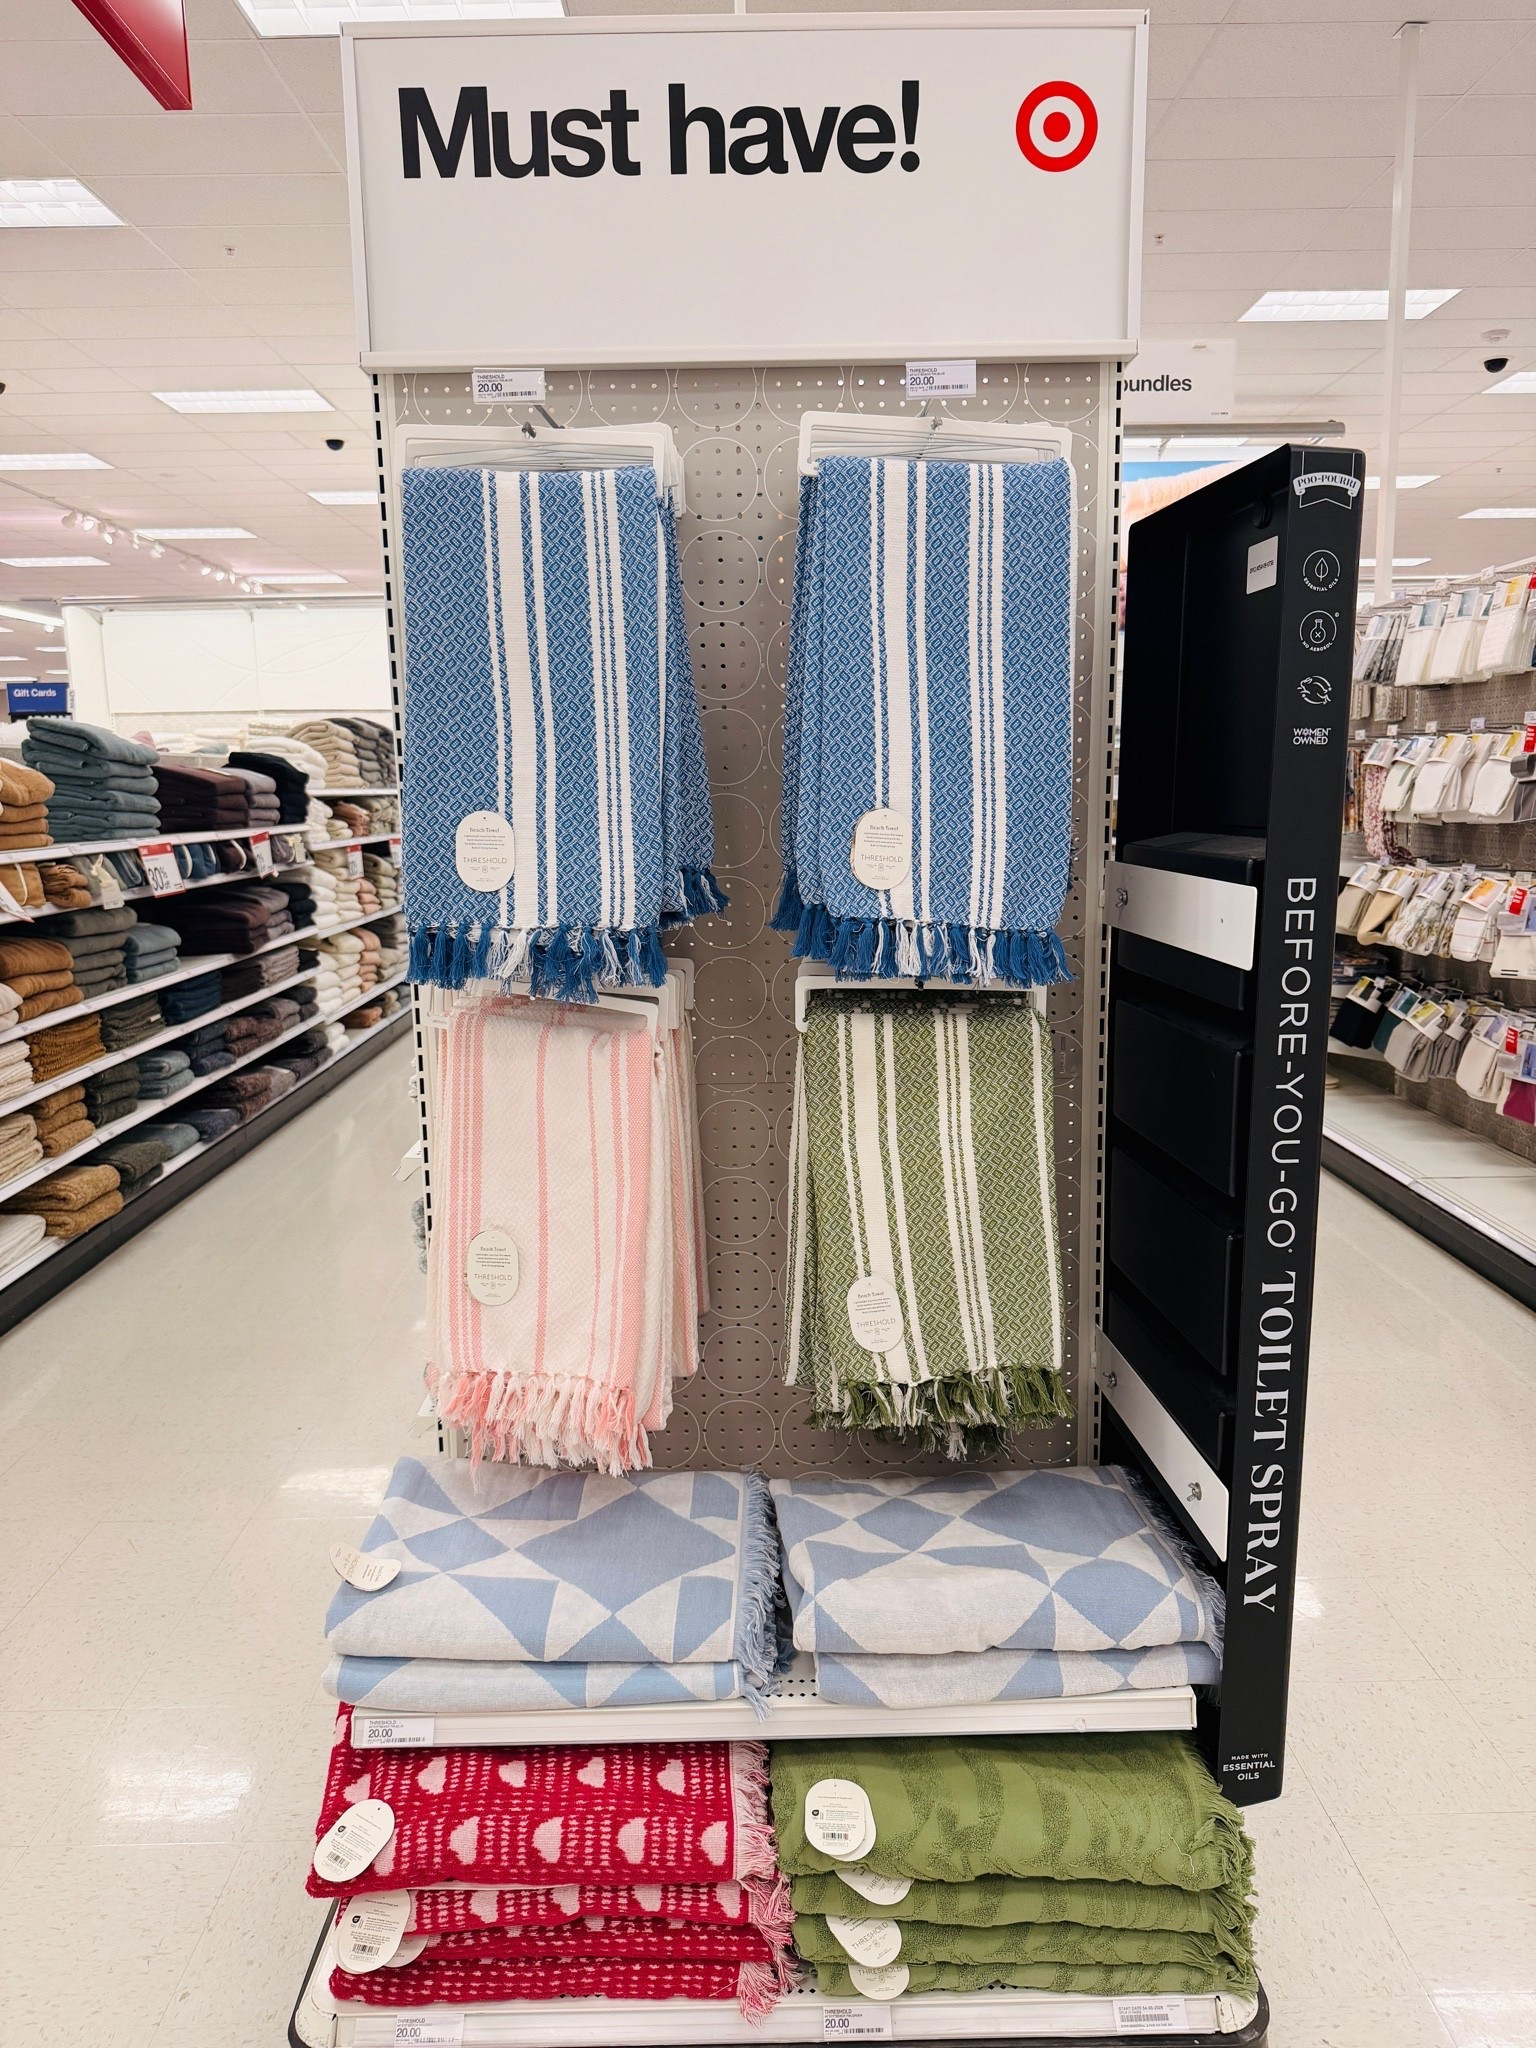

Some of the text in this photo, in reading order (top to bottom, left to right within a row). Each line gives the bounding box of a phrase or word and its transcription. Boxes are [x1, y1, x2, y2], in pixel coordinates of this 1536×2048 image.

[398, 80, 920, 179] Must have!
[909, 376, 934, 386] 20.00
[478, 383, 503, 393] 20.00
[1297, 474, 1357, 489] POO-POURRI
[1303, 577, 1339, 592] ESSENTIAL OILS
[1302, 640, 1333, 652] NO AEROSOL
[13, 688, 57, 697] Gift Cards
[1293, 736, 1328, 745] OWNED
[861, 854, 904, 863] THRESHOLD
[1243, 878, 1317, 1613] BEFORE-YOU-GO TOILET SPRAY
[474, 1273, 513, 1281] THRESHOLD
[856, 1317, 896, 1328] THRESHOLD
[368, 1728, 393, 1738] 20.00
[1222, 1760, 1276, 1772] ESSENTIAL
[1237, 1772, 1260, 1781] OILS
[851, 1921, 889, 1950] THRESHOLD
[858, 1965, 903, 1976] THRESHOLD
[825, 2018, 850, 2029] 20.00
[396, 2028, 421, 2038] 20.00
